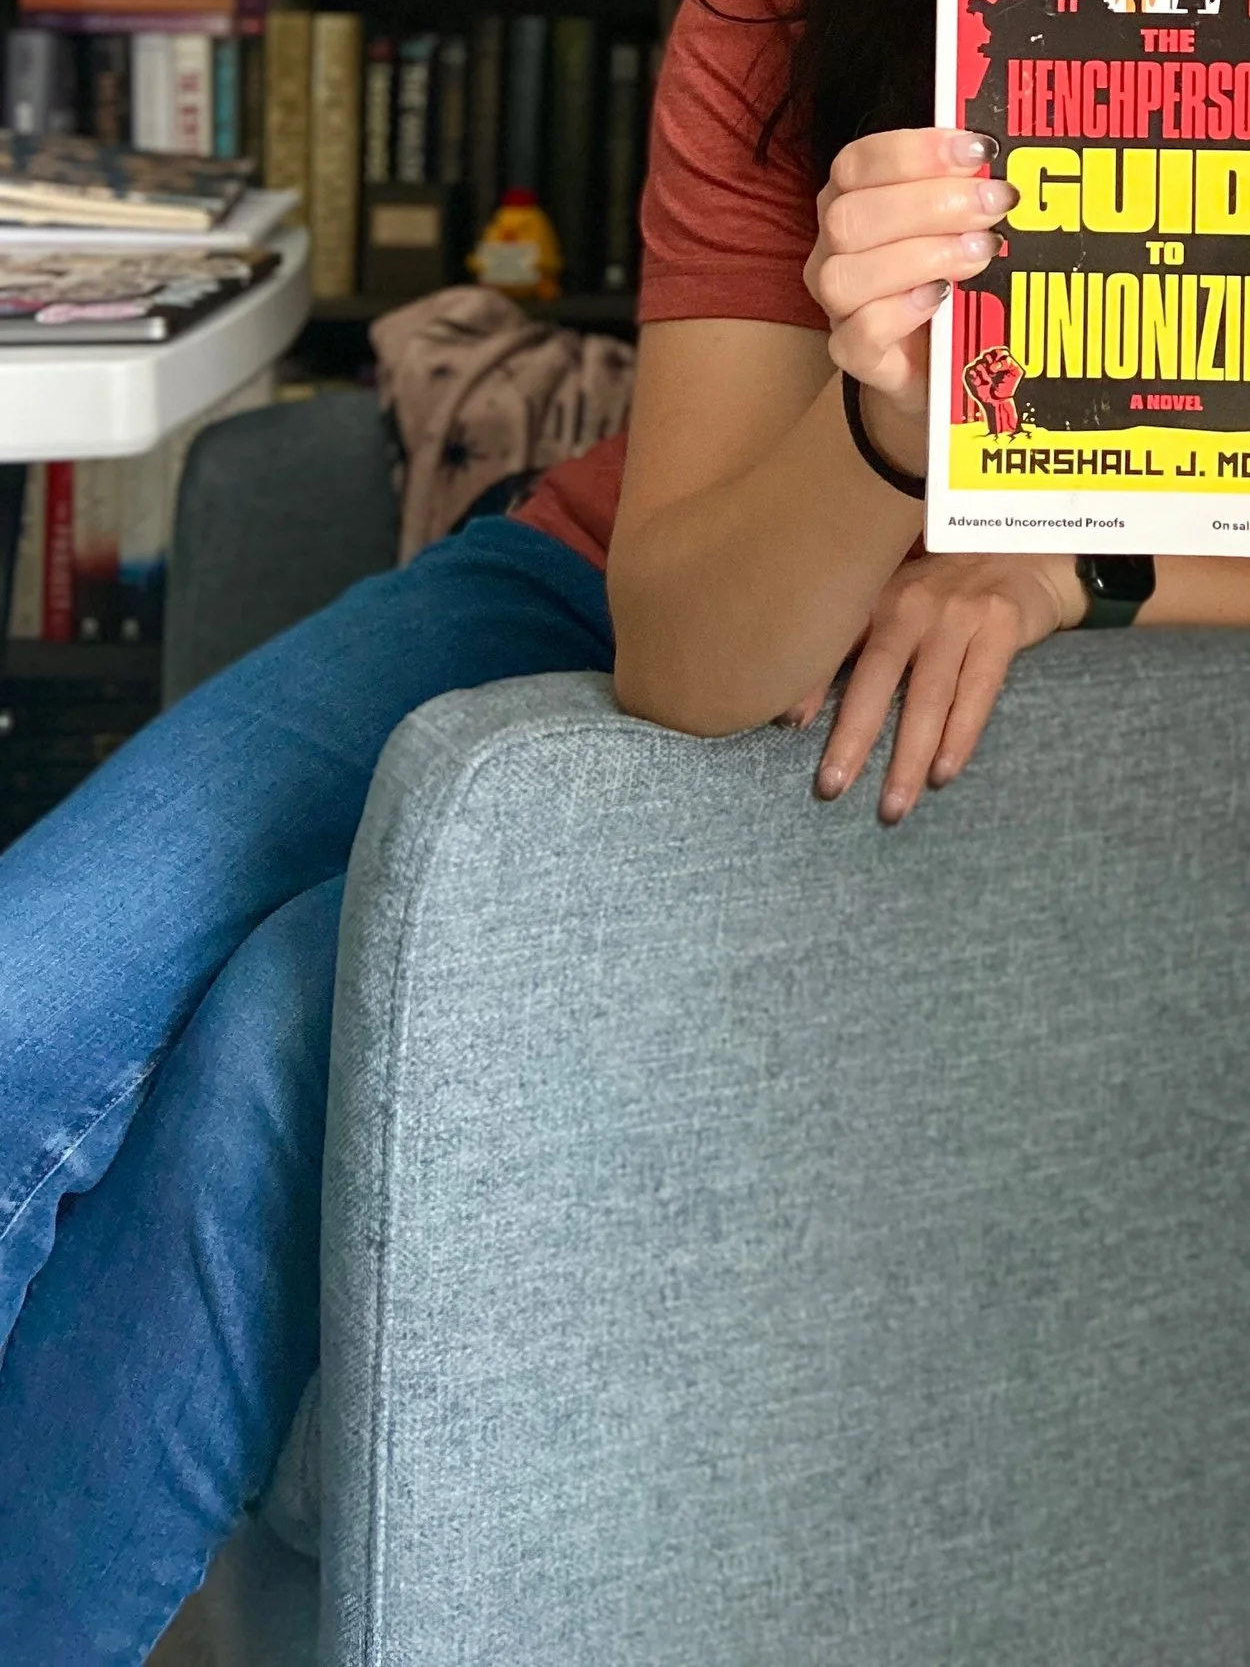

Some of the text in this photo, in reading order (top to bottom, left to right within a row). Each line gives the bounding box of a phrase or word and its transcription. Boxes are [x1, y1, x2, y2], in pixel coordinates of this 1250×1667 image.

[1140, 29, 1195, 53] THE
[1146, 241, 1184, 266] TO
[1130, 395, 1204, 411] A NOVEL
[981, 448, 1164, 477] MARSHALL
[1175, 451, 1206, 478] J.
[948, 516, 1125, 530] Advance Uncorrected Proofs
[1212, 520, 1230, 532] On
